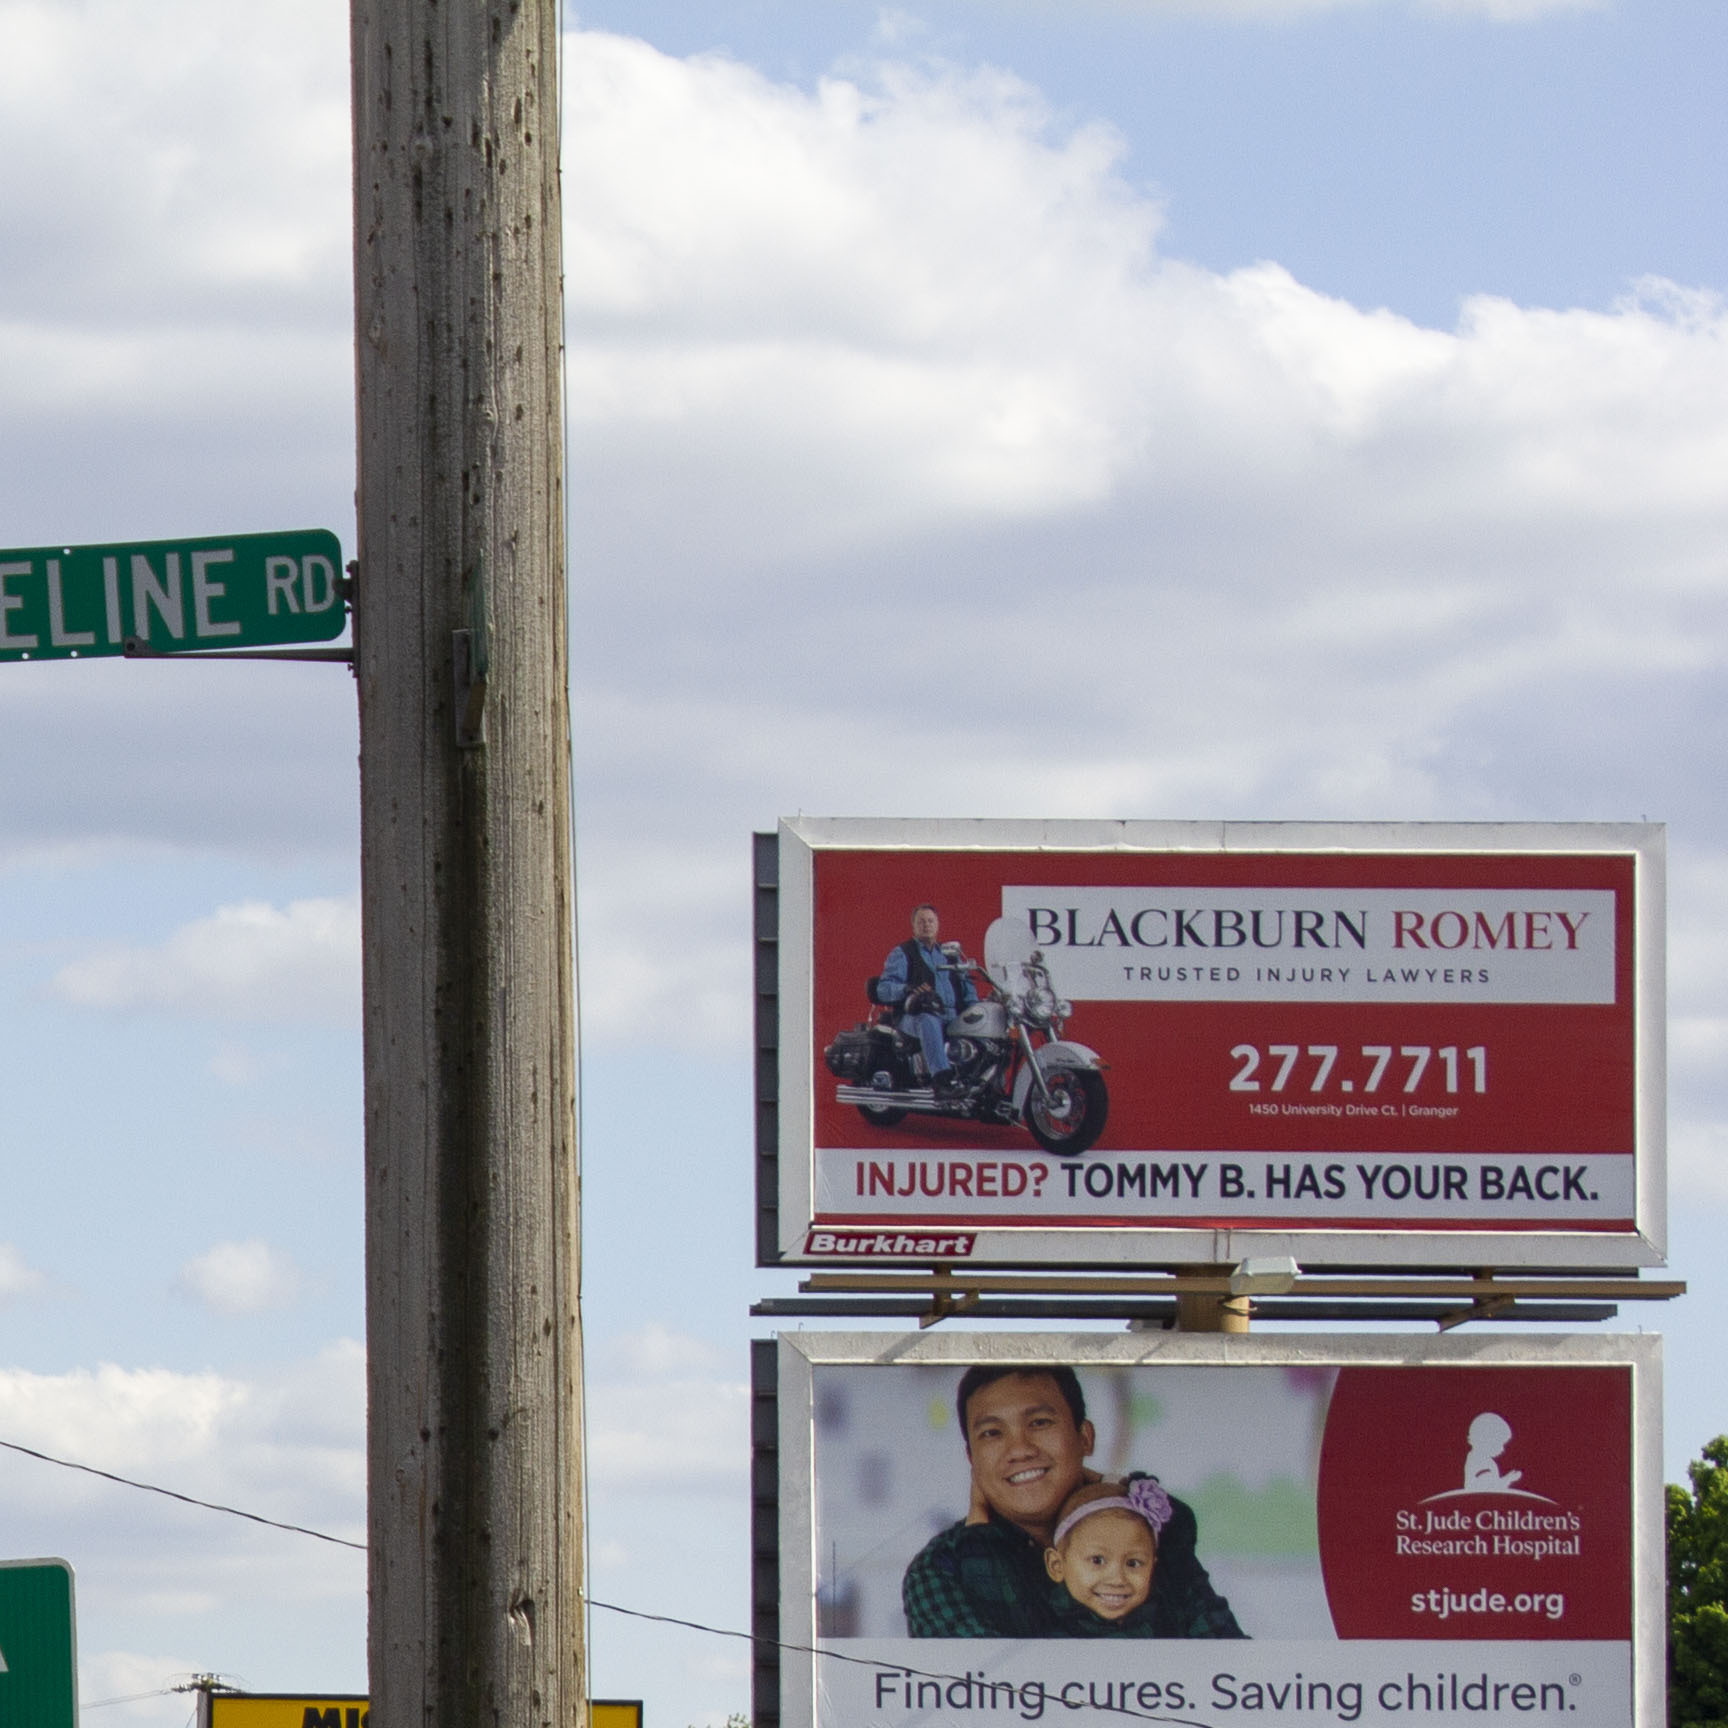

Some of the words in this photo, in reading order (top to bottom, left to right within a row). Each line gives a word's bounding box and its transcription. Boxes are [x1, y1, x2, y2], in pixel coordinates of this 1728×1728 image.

[265, 554, 338, 615] RD
[1028, 908, 1368, 950] BLACKBURN
[1392, 910, 1591, 951] ROMEY
[1123, 966, 1241, 982] TRUSTED
[1255, 966, 1351, 983] INJURY
[1366, 967, 1491, 984] LAWYERS
[1229, 1044, 1487, 1095] 277.7711
[1249, 1103, 1279, 1116] 1450
[1282, 1103, 1342, 1119] University
[1345, 1104, 1377, 1116] Drive
[1379, 1104, 1398, 1117] Ct.
[1409, 1105, 1459, 1120] Granger
[855, 1161, 1049, 1199] INJURED?
[1061, 1163, 1209, 1199] TOMMY
[1220, 1164, 1257, 1200] B.
[1267, 1164, 1345, 1200] HAS
[1356, 1165, 1469, 1201] YOUR
[1482, 1166, 1600, 1202] BACK.
[811, 1233, 969, 1256] Burkhart
[1396, 1510, 1421, 1531] St.
[1425, 1510, 1470, 1532] Jude
[1474, 1510, 1581, 1532] Children's
[1397, 1535, 1488, 1555] Research
[1493, 1535, 1581, 1560] Hospital
[1411, 1589, 1565, 1620] stjude.org
[875, 1672, 1046, 1720] Finding
[1060, 1680, 1197, 1711] cures.
[1210, 1674, 1364, 1720] Saving
